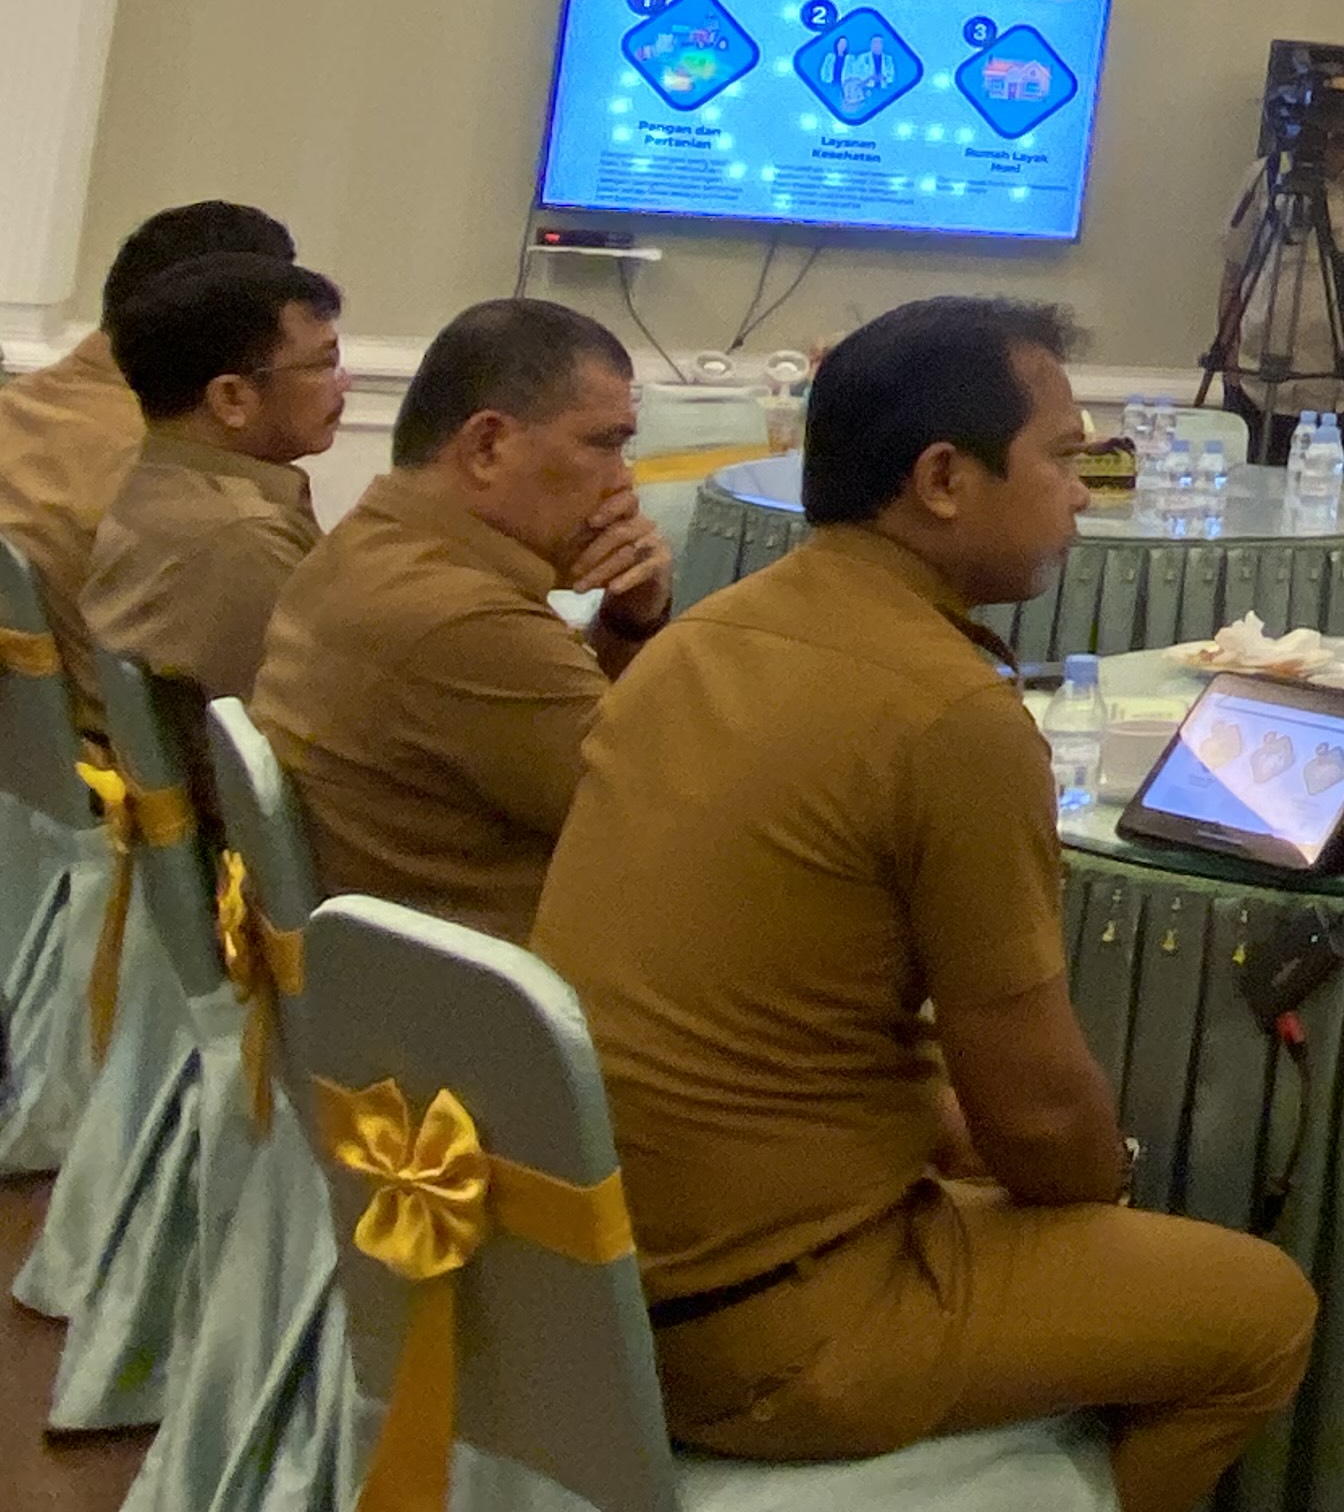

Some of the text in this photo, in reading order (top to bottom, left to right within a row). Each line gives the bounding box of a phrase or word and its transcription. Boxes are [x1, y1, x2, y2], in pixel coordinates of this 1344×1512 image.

[812, 6, 827, 25] 2
[973, 23, 987, 40] 3
[695, 125, 721, 136] dan
